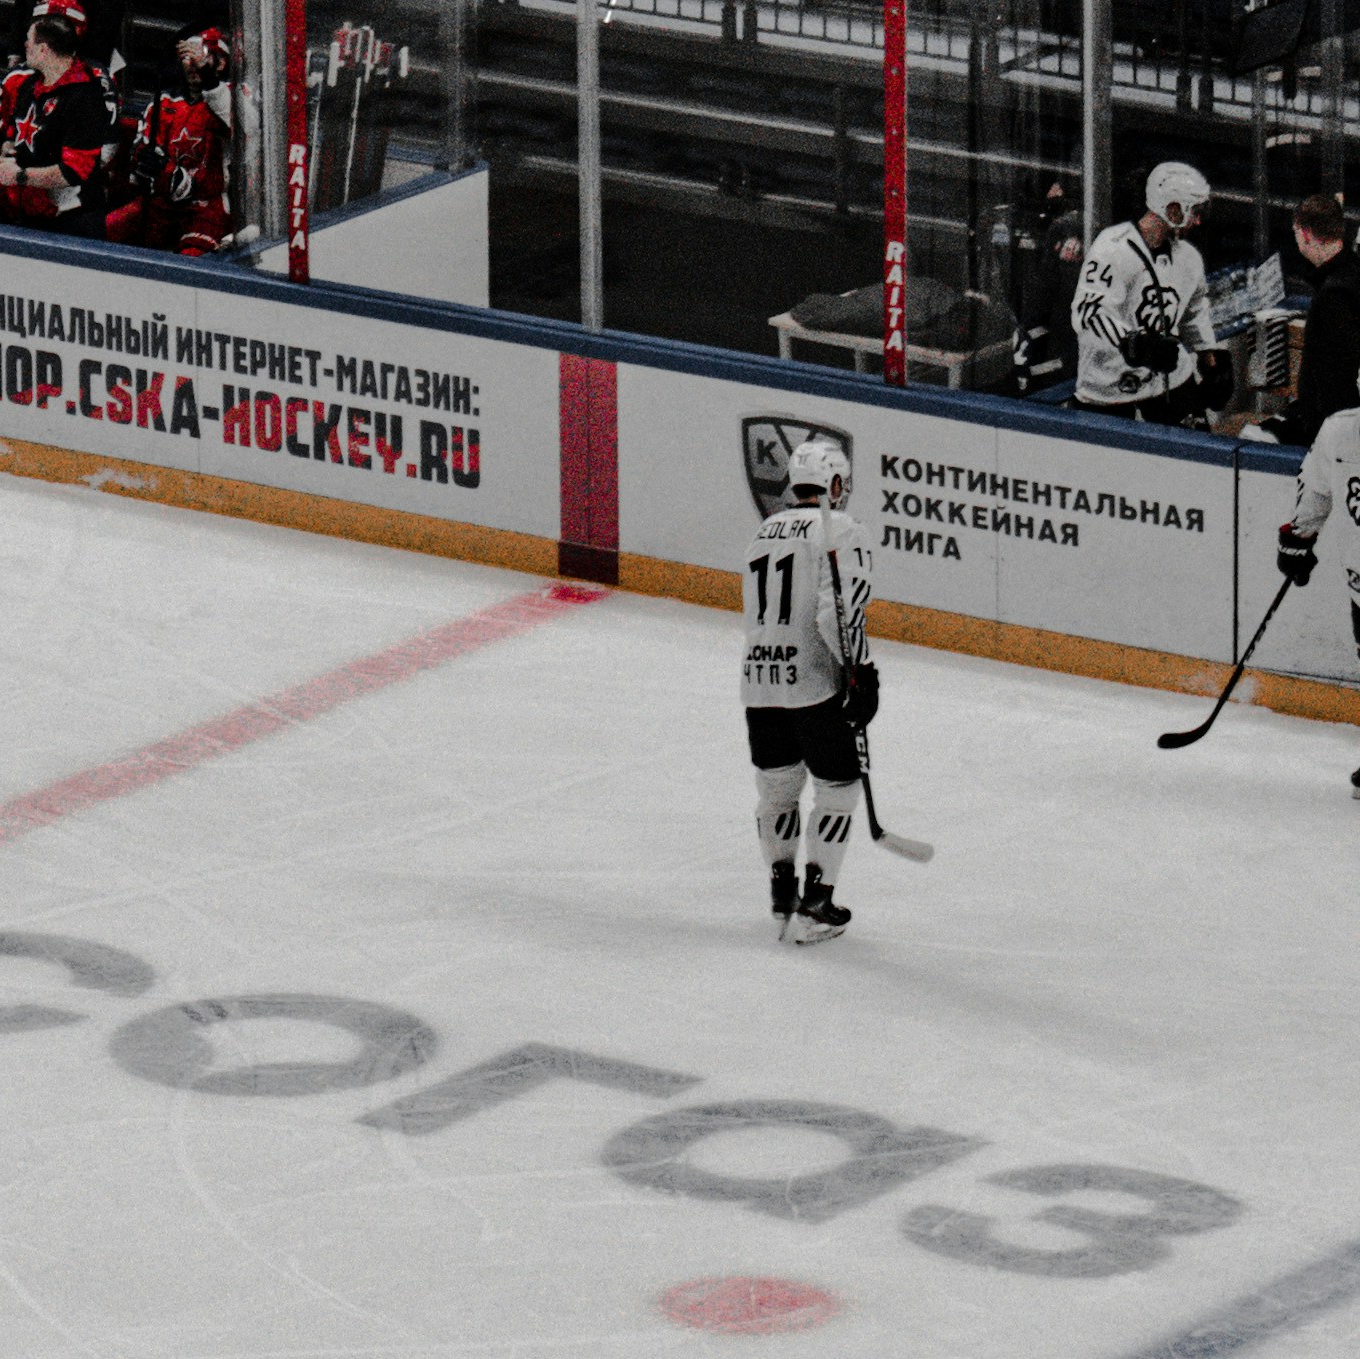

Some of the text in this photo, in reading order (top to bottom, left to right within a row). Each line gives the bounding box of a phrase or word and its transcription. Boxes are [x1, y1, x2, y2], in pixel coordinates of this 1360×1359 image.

[288, 143, 306, 251] RAITA
[885, 241, 905, 352] RAITA
[1085, 260, 1113, 289] 24
[177, 326, 481, 416] ИНТЕРНЕТ-МАГАЗИН:
[881, 454, 1205, 533] КОНТИНЕНТАЛЬНАЯ
[882, 490, 1079, 546] ХОККЕЙНАЯ
[881, 524, 962, 560] ЛИГА
[749, 553, 795, 625] 11
